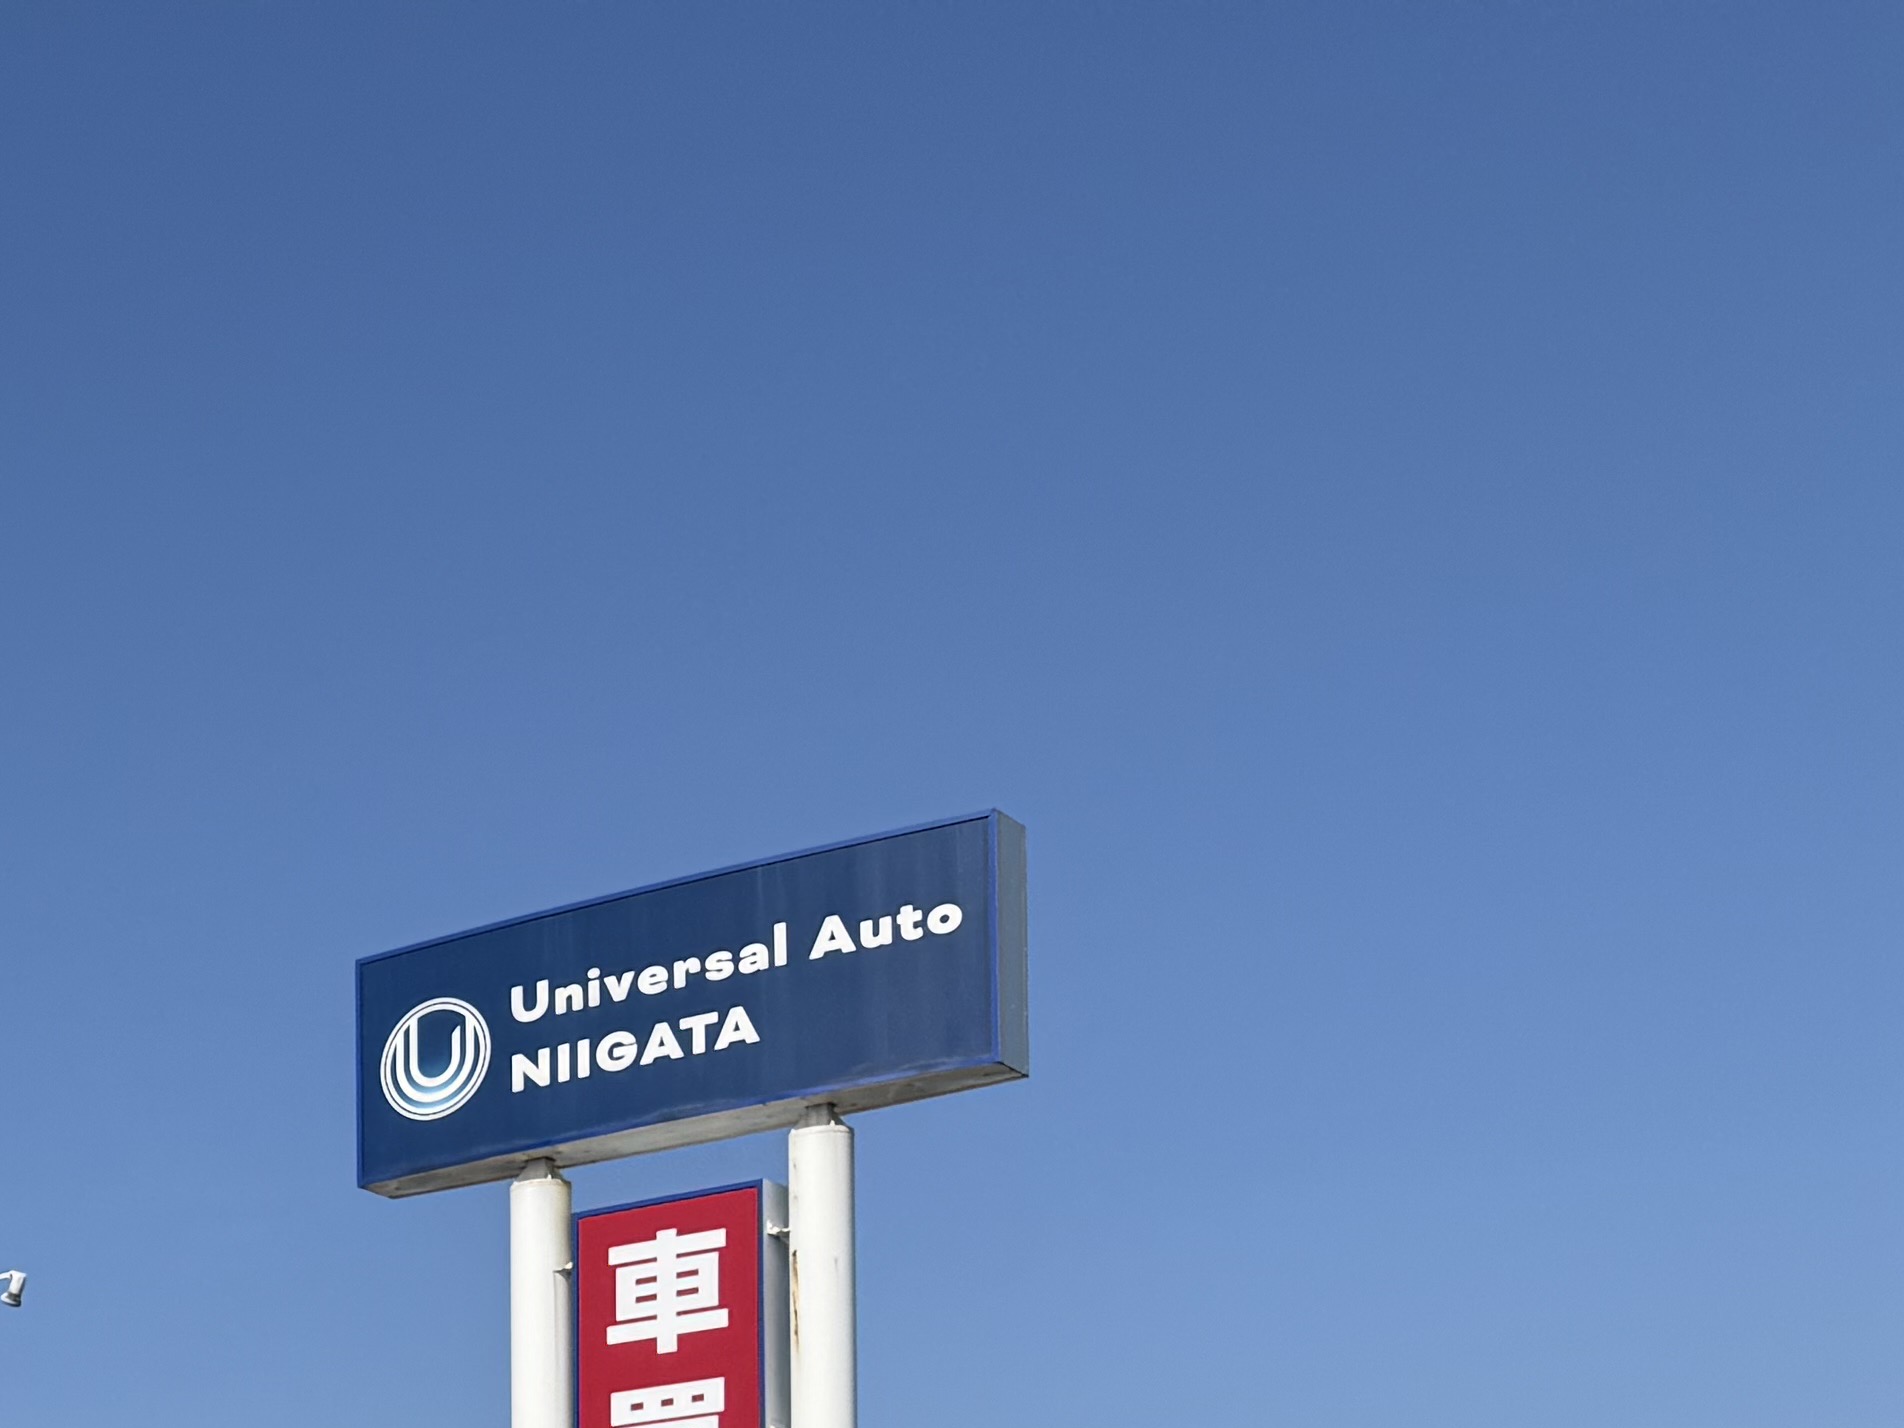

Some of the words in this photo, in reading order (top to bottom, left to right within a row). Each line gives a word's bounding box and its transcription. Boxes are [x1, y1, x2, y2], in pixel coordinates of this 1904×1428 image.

[511, 923, 787, 1023] Universal
[809, 903, 963, 960] Auto
[511, 1006, 760, 1093] NIIGATA
